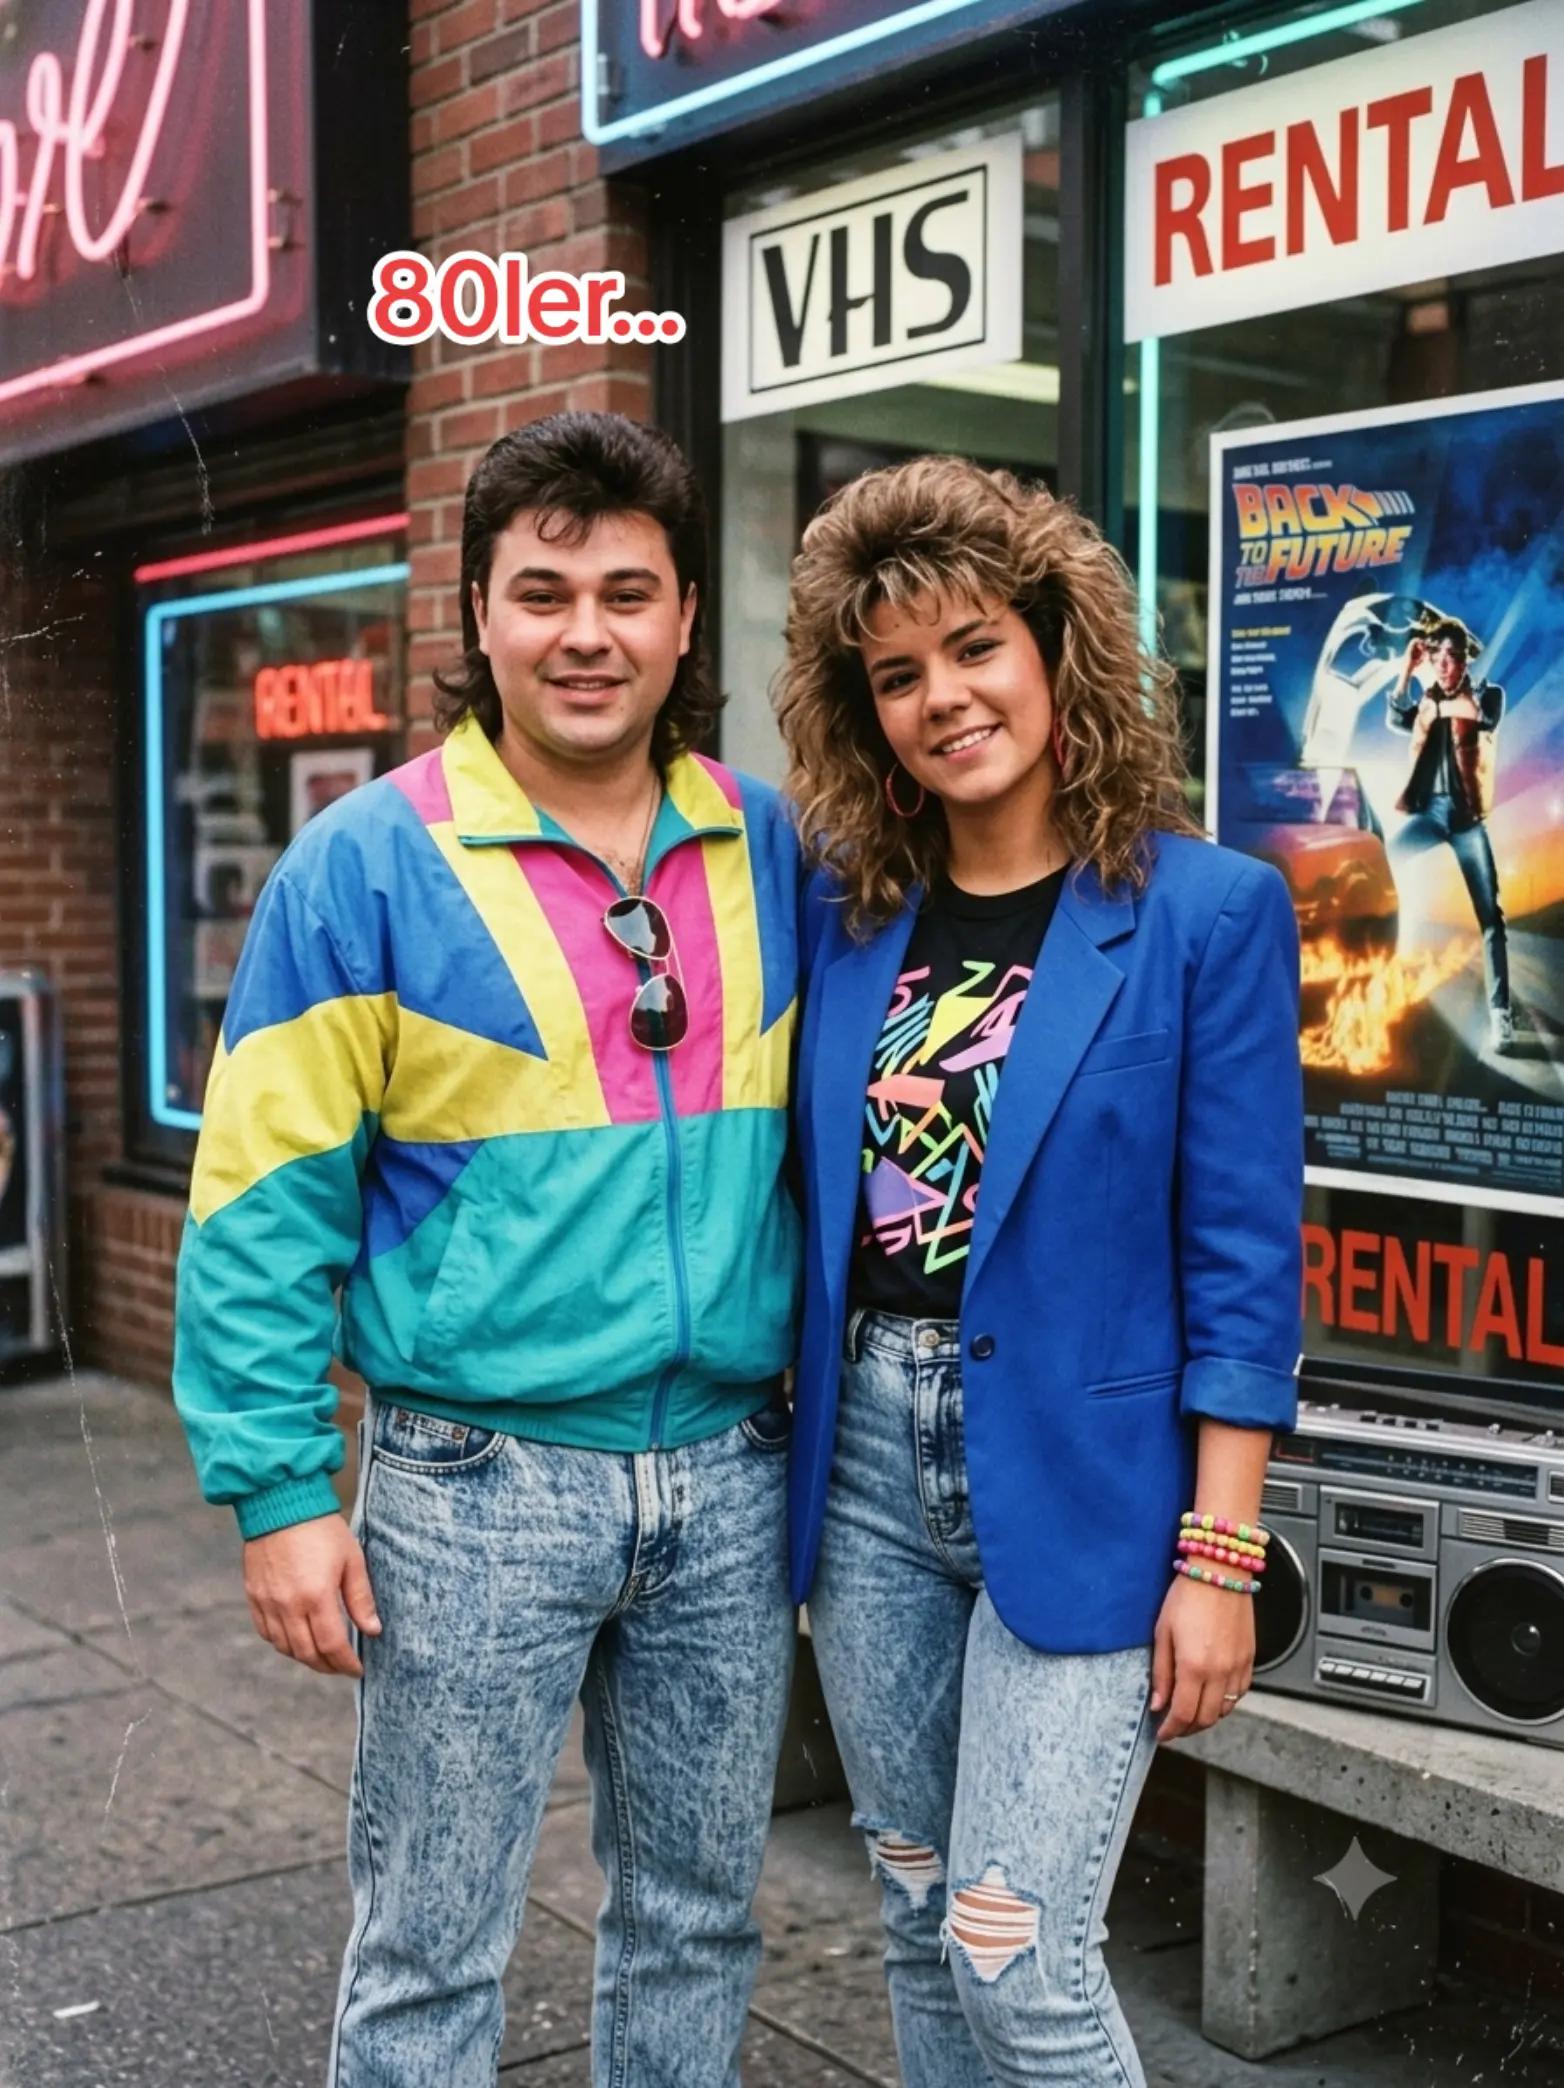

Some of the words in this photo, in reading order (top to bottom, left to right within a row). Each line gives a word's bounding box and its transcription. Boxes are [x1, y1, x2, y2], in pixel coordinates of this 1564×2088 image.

[1154, 53, 1564, 287] RENTAL
[762, 189, 972, 368] VHS
[1232, 483, 1384, 540] BACK
[1240, 540, 1268, 566] TO
[1265, 525, 1413, 586] FUTURE
[1301, 1222, 1564, 1368] RENTAL
